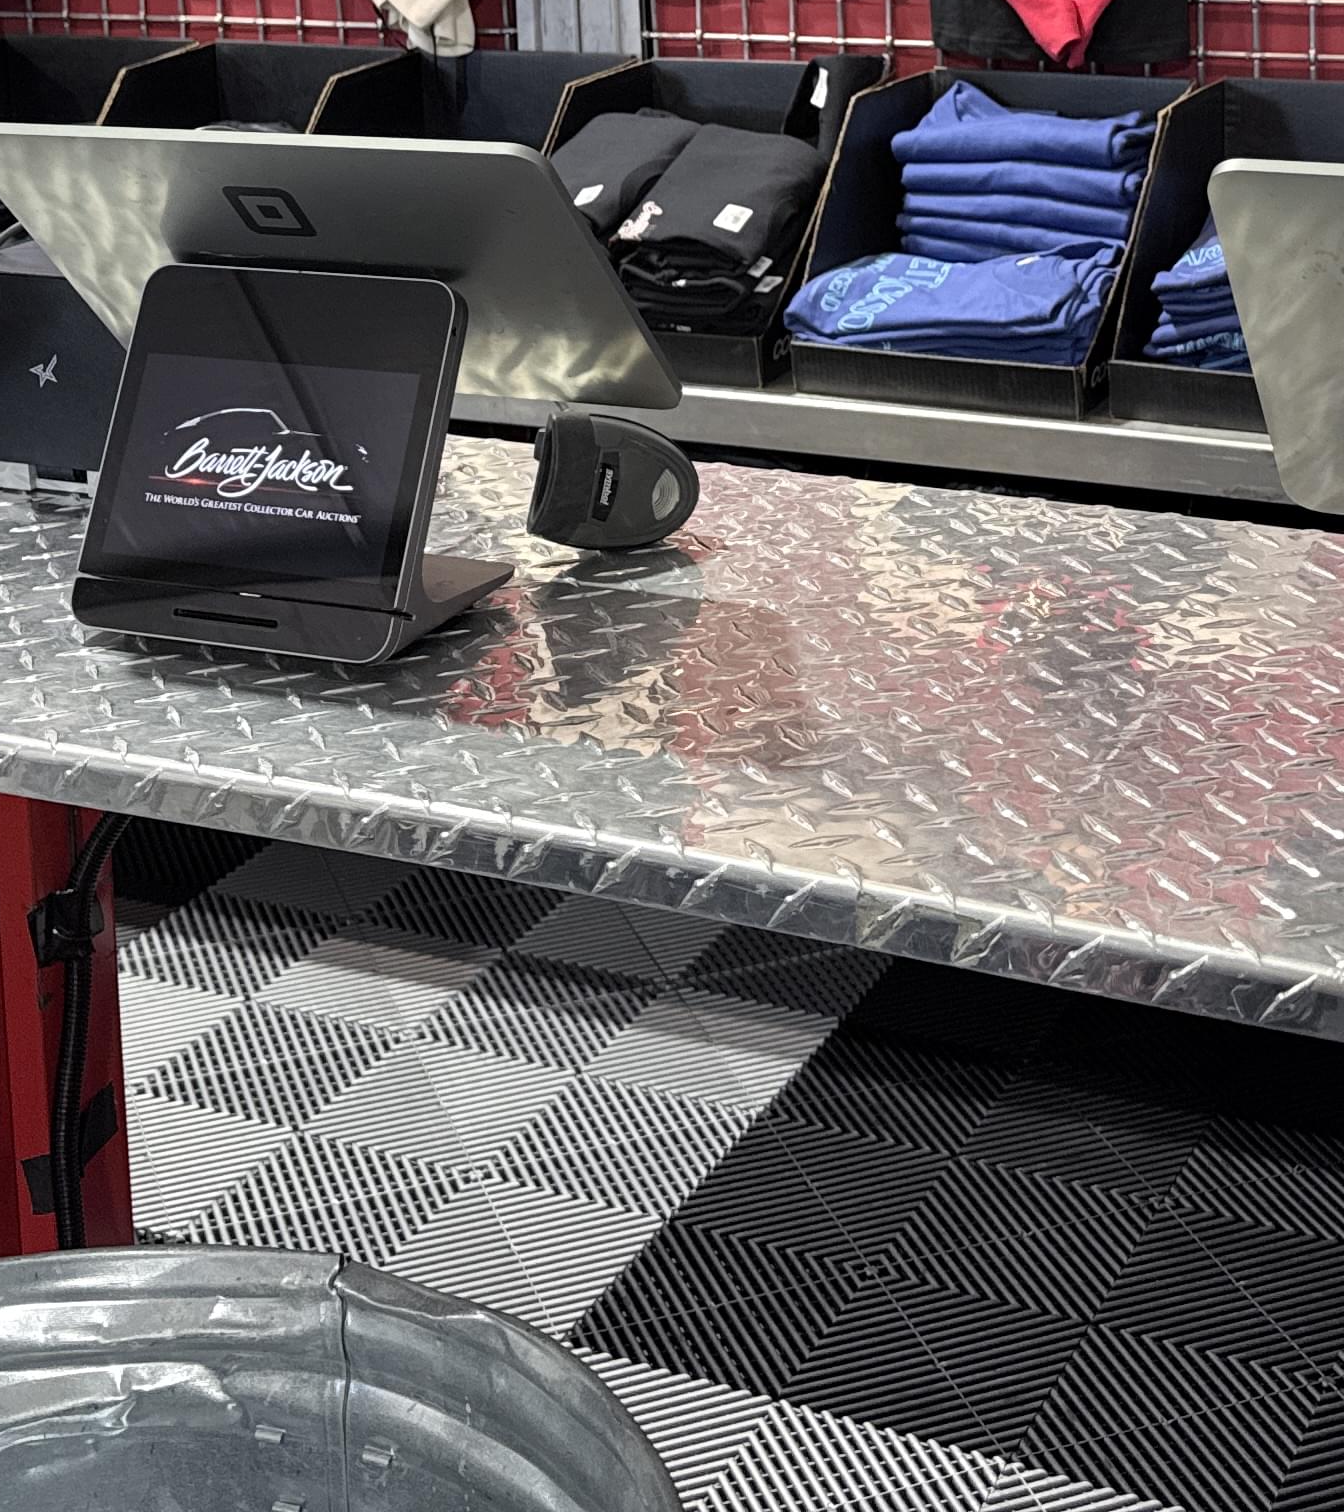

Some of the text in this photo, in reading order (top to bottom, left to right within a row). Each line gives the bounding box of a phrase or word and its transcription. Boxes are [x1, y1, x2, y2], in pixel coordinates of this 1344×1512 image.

[165, 437, 354, 498] Barrett-Jackson
[145, 492, 162, 503] THE
[163, 495, 199, 507] WORLD'S
[200, 498, 242, 511] GREATEST
[243, 502, 294, 517] COLLECTOR
[294, 508, 314, 519] CAR
